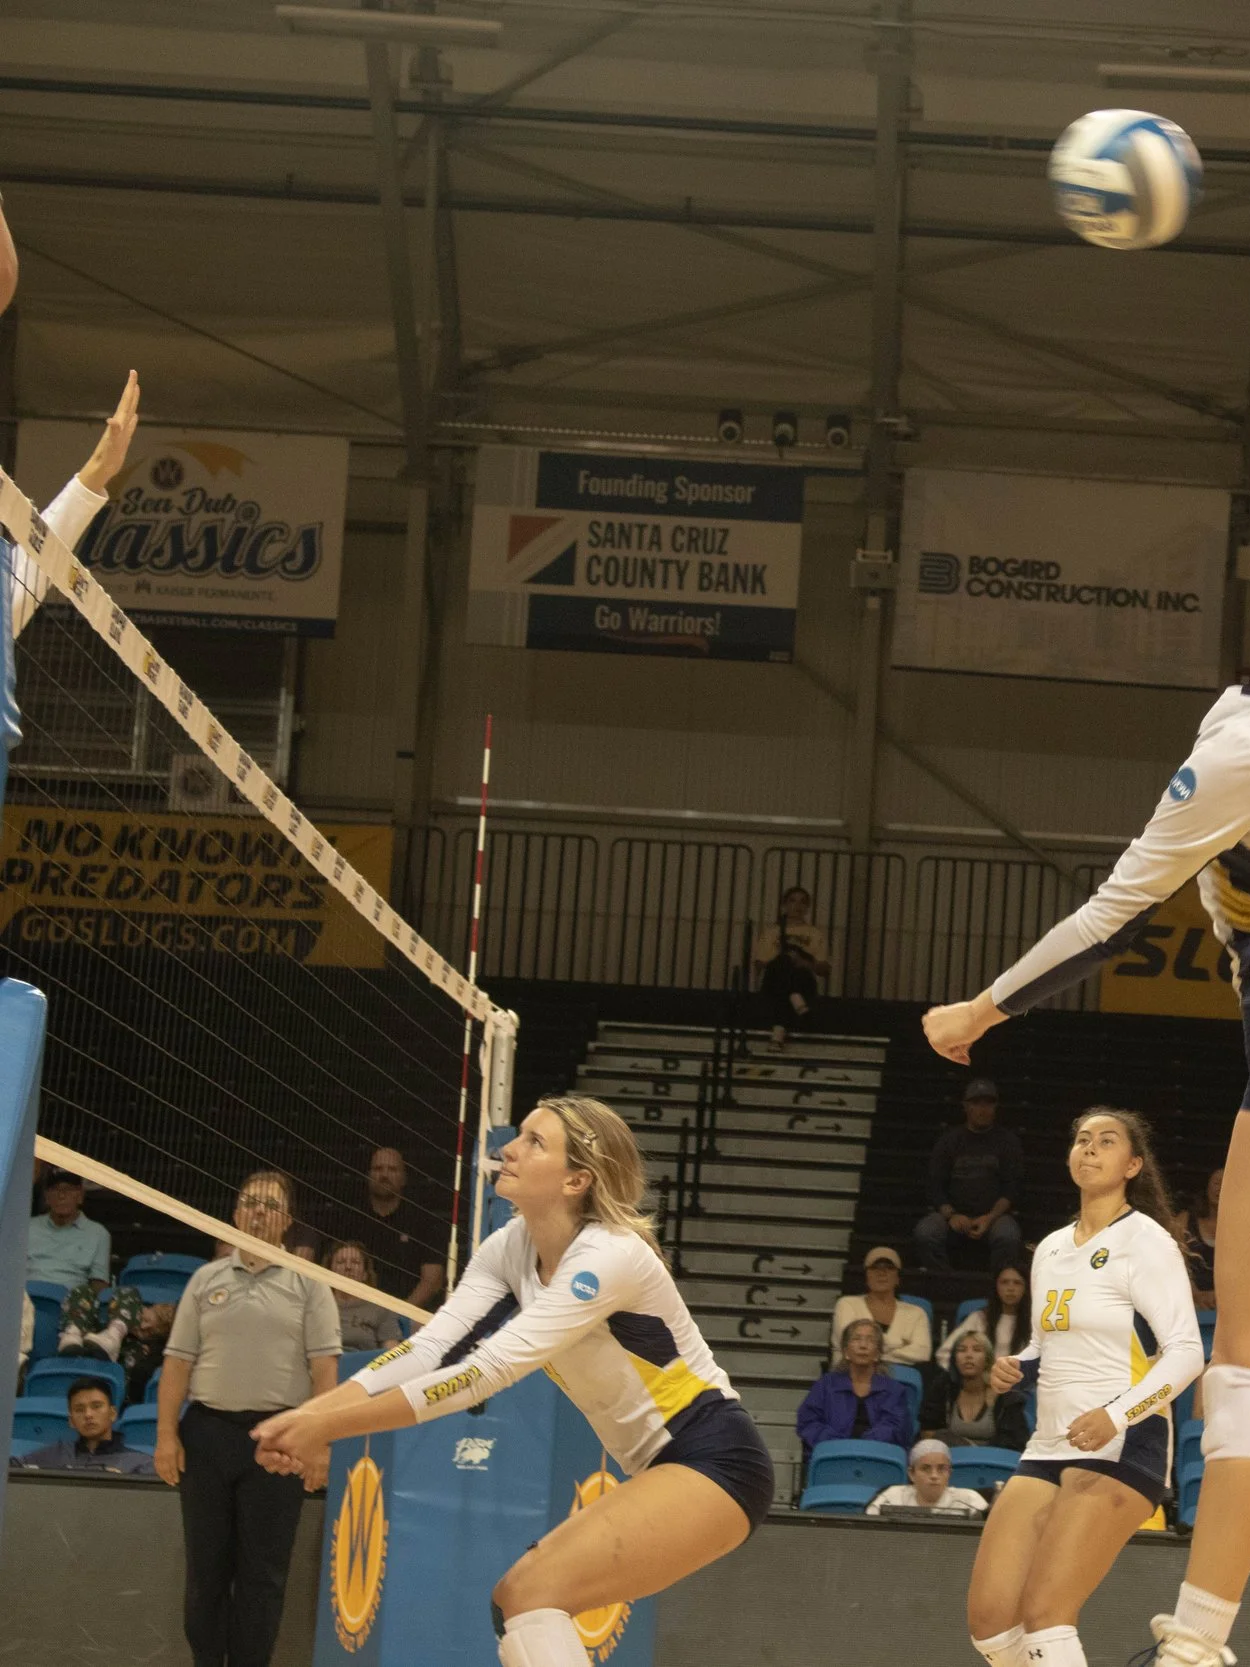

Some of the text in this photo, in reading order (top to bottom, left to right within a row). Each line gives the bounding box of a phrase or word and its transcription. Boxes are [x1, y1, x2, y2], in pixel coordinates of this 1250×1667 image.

[122, 487, 237, 516] Sea Dub
[578, 470, 757, 505] Founding Sponsor
[76, 500, 322, 581] lassics
[587, 520, 731, 556] SANTA CRUZ
[586, 555, 768, 595] COUNTY BANK
[968, 555, 1061, 580] BOGARD
[594, 605, 722, 636] Go Warriors!
[1156, 592, 1202, 614] INC.
[17, 818, 102, 857] NO
[110, 823, 337, 870] KNOW
[0, 858, 329, 910] PREDATORS
[20, 913, 298, 954] GOSLUGS.COM
[1041, 1288, 1077, 1331] 25
[1125, 1393, 1158, 1422] SLUGS
